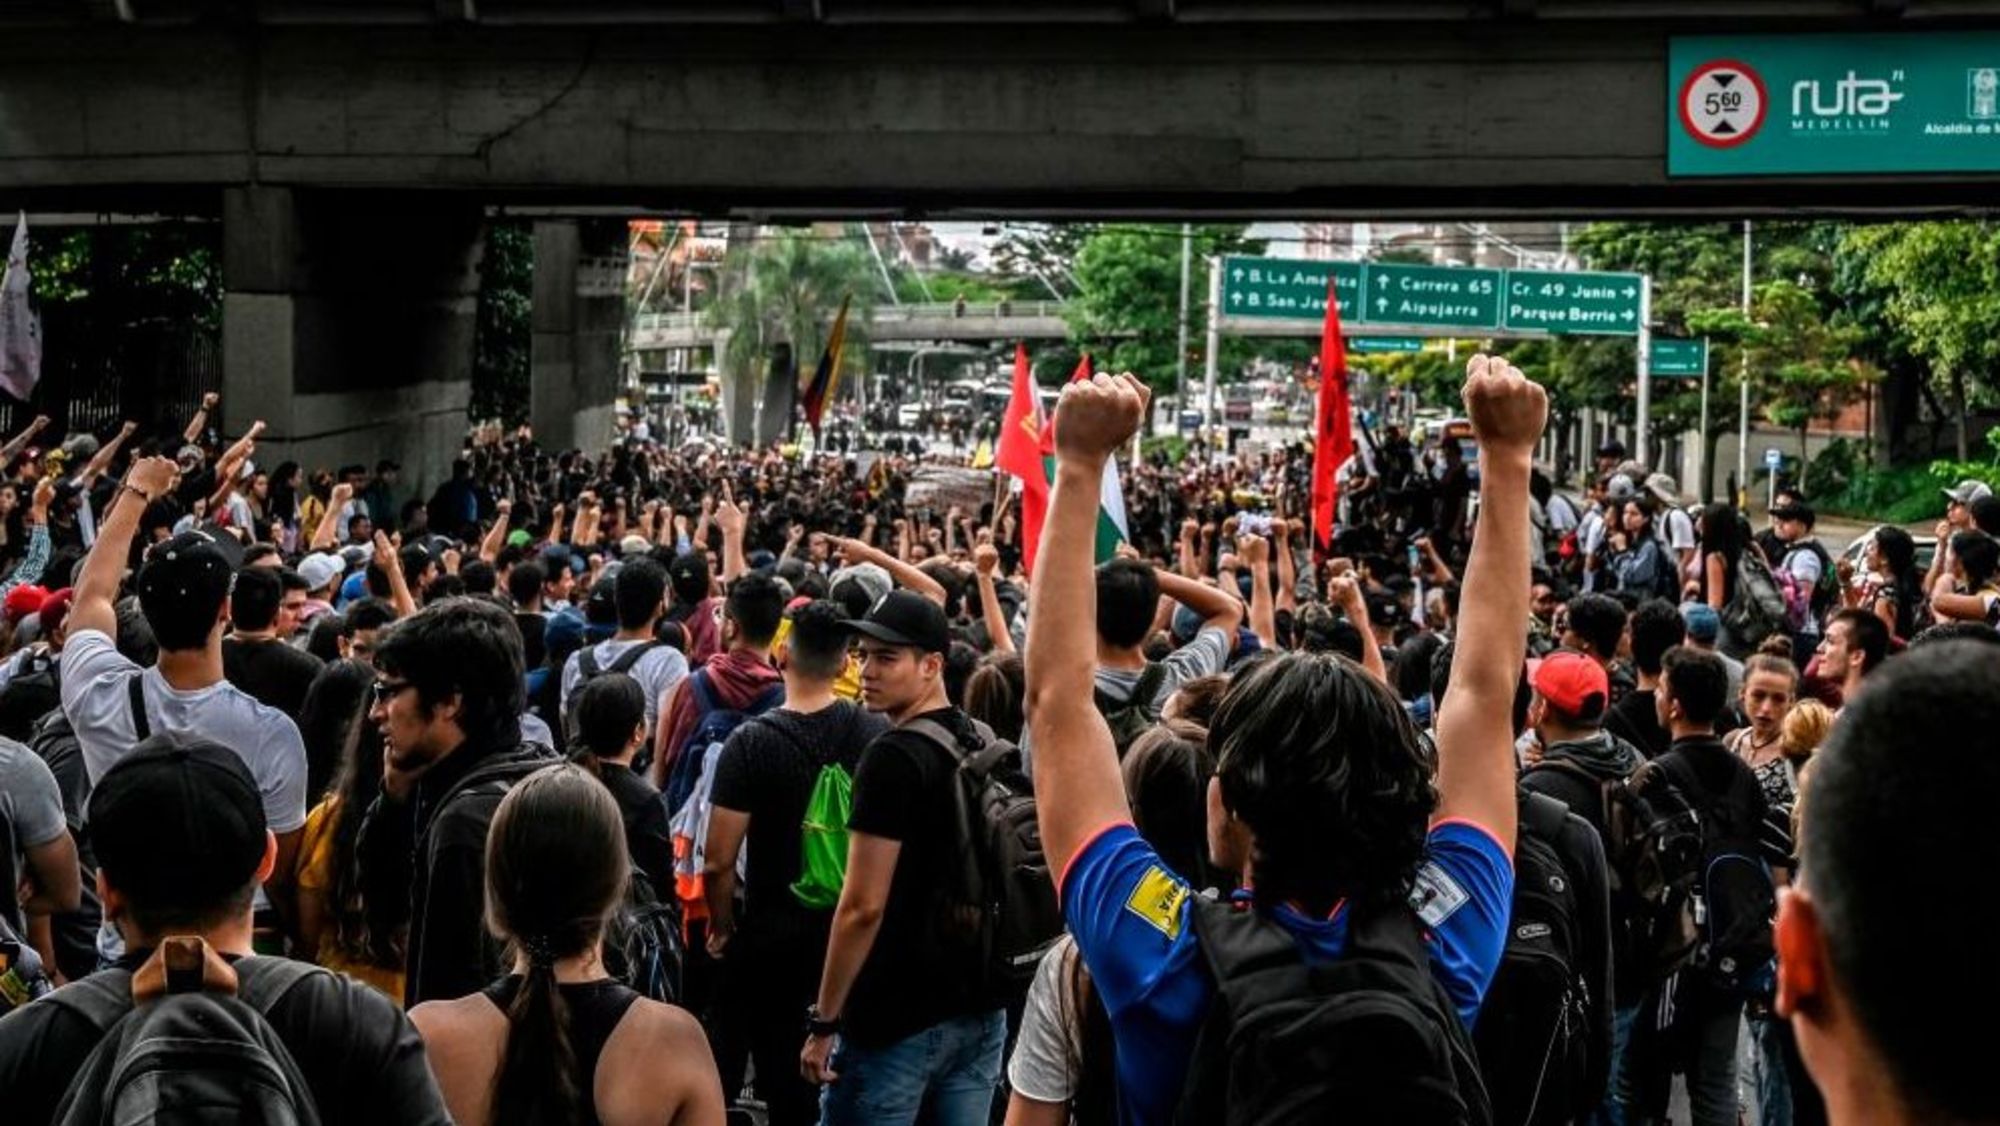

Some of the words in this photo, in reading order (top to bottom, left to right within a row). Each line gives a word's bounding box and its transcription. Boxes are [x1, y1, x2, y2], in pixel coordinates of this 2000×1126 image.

[1975, 123, 1992, 134] de
[1266, 270, 1288, 285] La
[1400, 276, 1460, 293] Carrera
[1467, 279, 1493, 295] 65
[1540, 283, 1565, 297] 49
[1266, 293, 1297, 308] San
[1510, 304, 1566, 323] Parque
